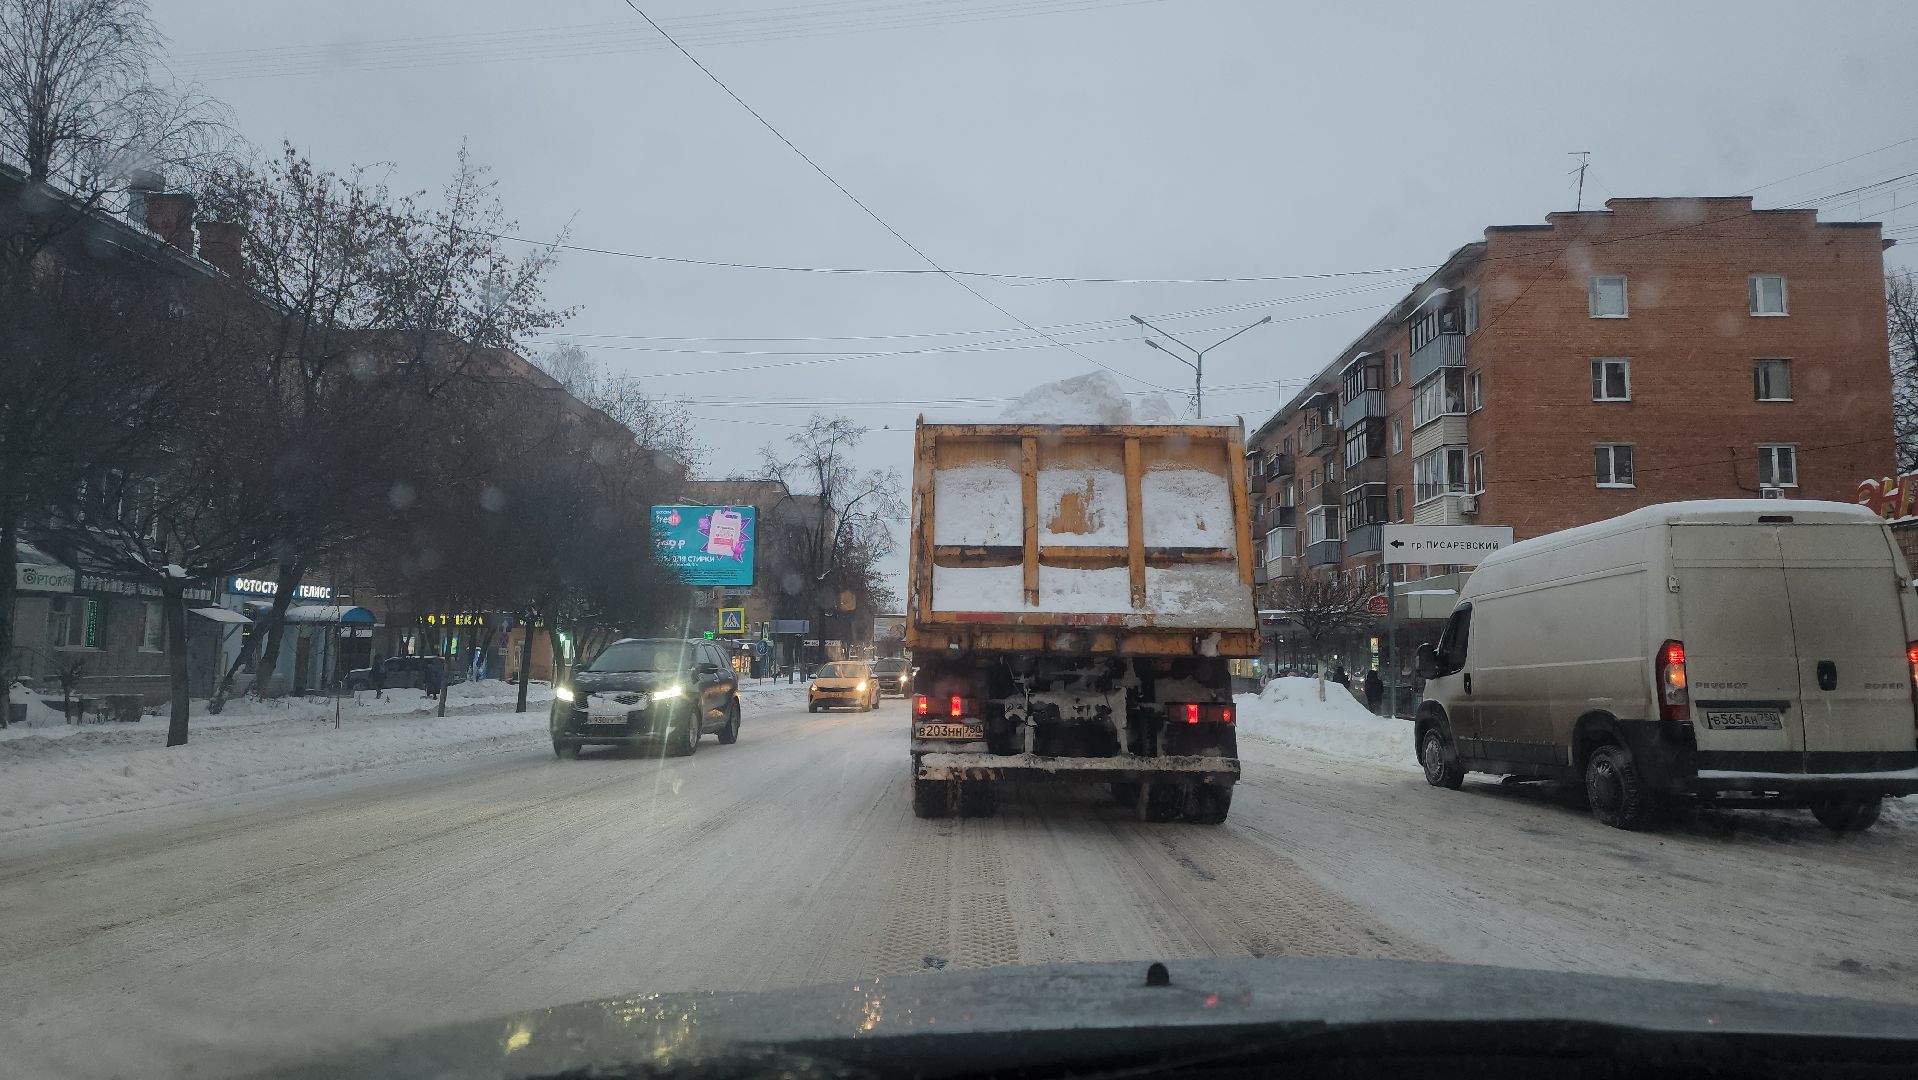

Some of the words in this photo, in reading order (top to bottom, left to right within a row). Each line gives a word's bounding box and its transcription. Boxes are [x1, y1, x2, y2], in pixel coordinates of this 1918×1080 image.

[1411, 542, 1424, 551] гр.
[1426, 540, 1499, 550] ПИСАРЕВСКИЙ
[1695, 681, 1749, 690] PEUGEOT
[1864, 682, 1904, 690] BOXER
